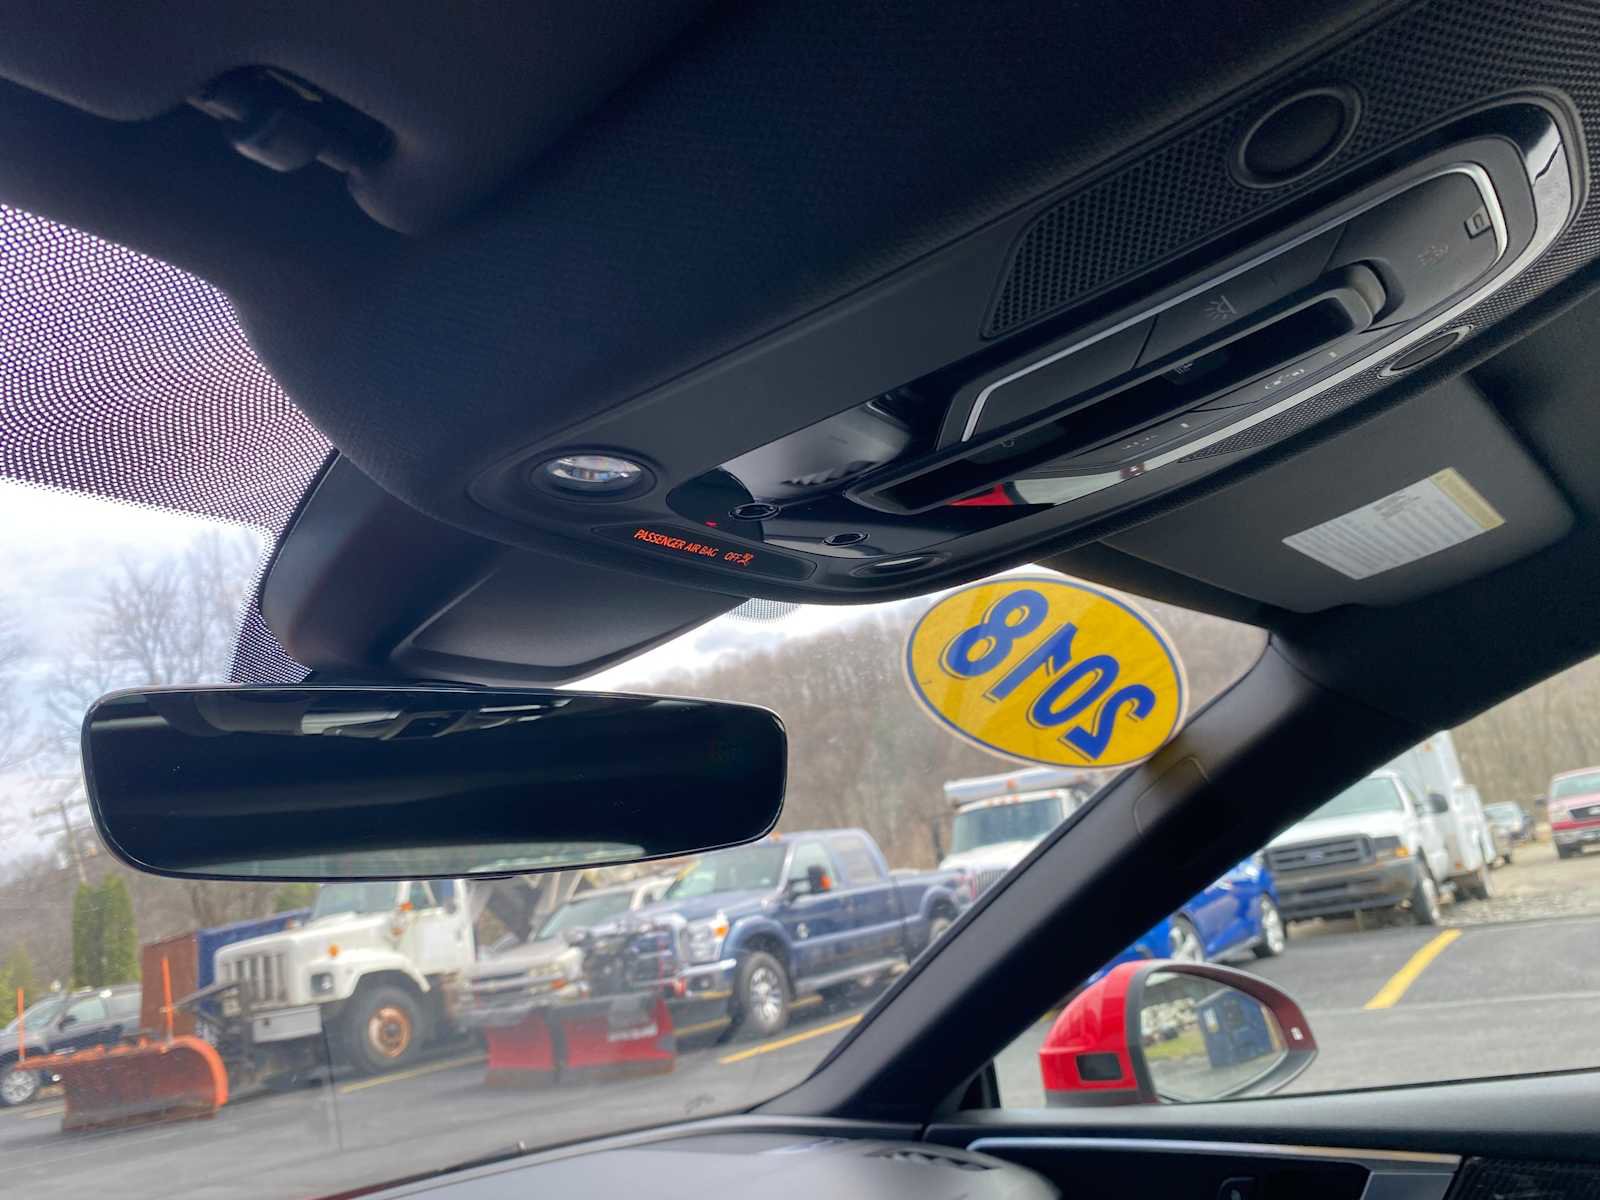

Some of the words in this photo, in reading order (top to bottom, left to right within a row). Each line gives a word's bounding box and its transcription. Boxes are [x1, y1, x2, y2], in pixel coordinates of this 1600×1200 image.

[633, 528, 687, 550] PASSENGER
[684, 543, 702, 553] AIR
[698, 545, 719, 558] BAG
[723, 551, 742, 561] OFF
